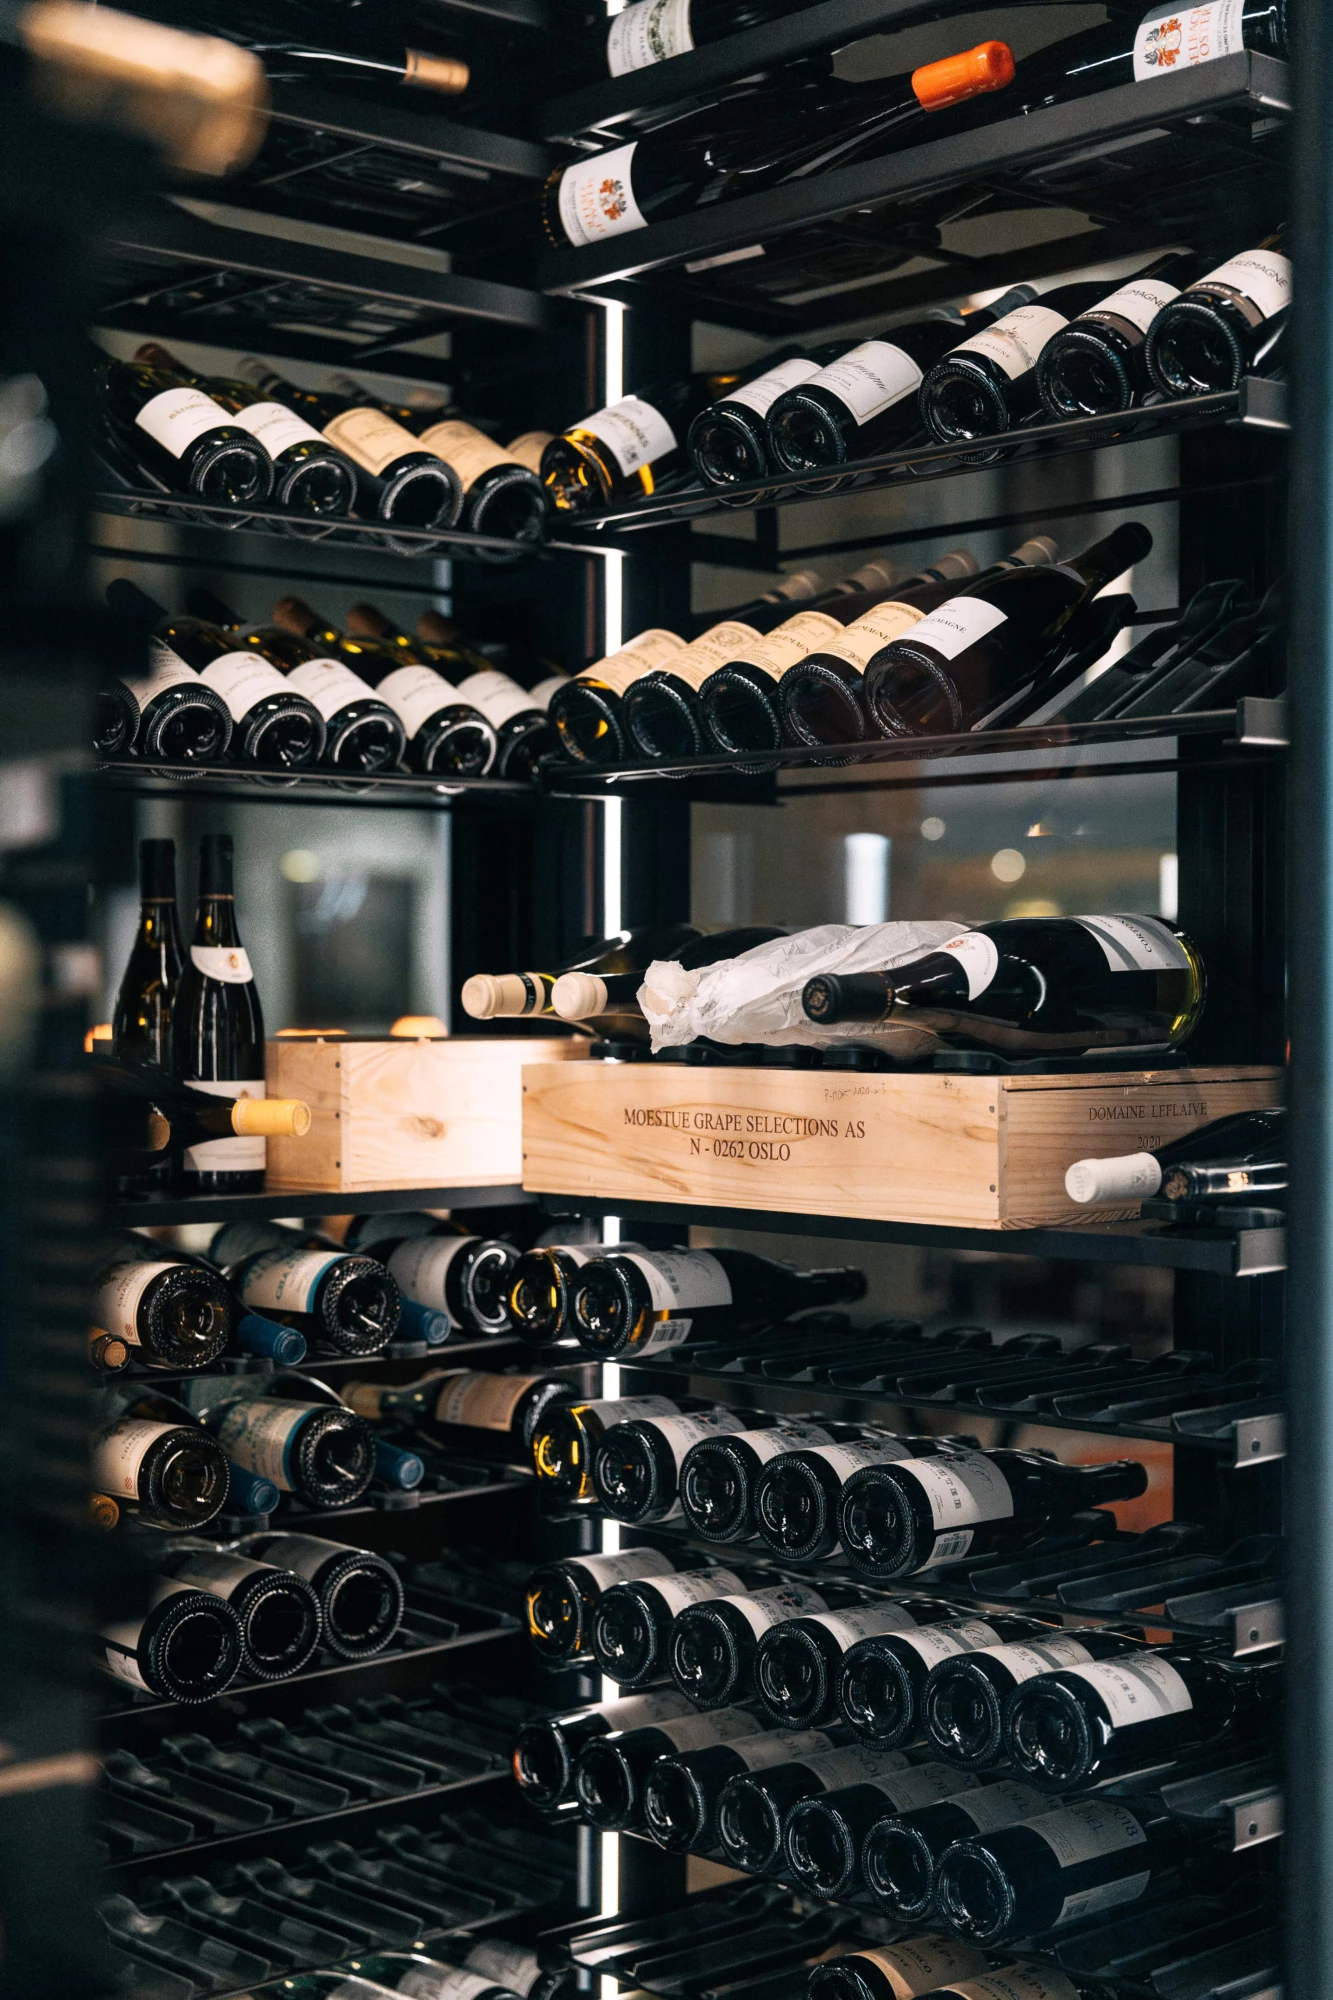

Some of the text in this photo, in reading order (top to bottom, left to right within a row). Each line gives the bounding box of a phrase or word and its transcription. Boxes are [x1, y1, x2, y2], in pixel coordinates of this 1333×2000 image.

[1199, 6, 1213, 56] OSTER
[623, 1107, 866, 1139] MOESTUE GRAPE SELECTIONS AS
[1088, 1101, 1208, 1122] DOMAINE LEFLAIVE
[689, 1137, 701, 1156] N
[713, 1138, 745, 1159] 0262
[748, 1141, 791, 1162] OSLO
[1136, 1135, 1161, 1150] 2020
[1106, 1804, 1139, 1837] 2018
